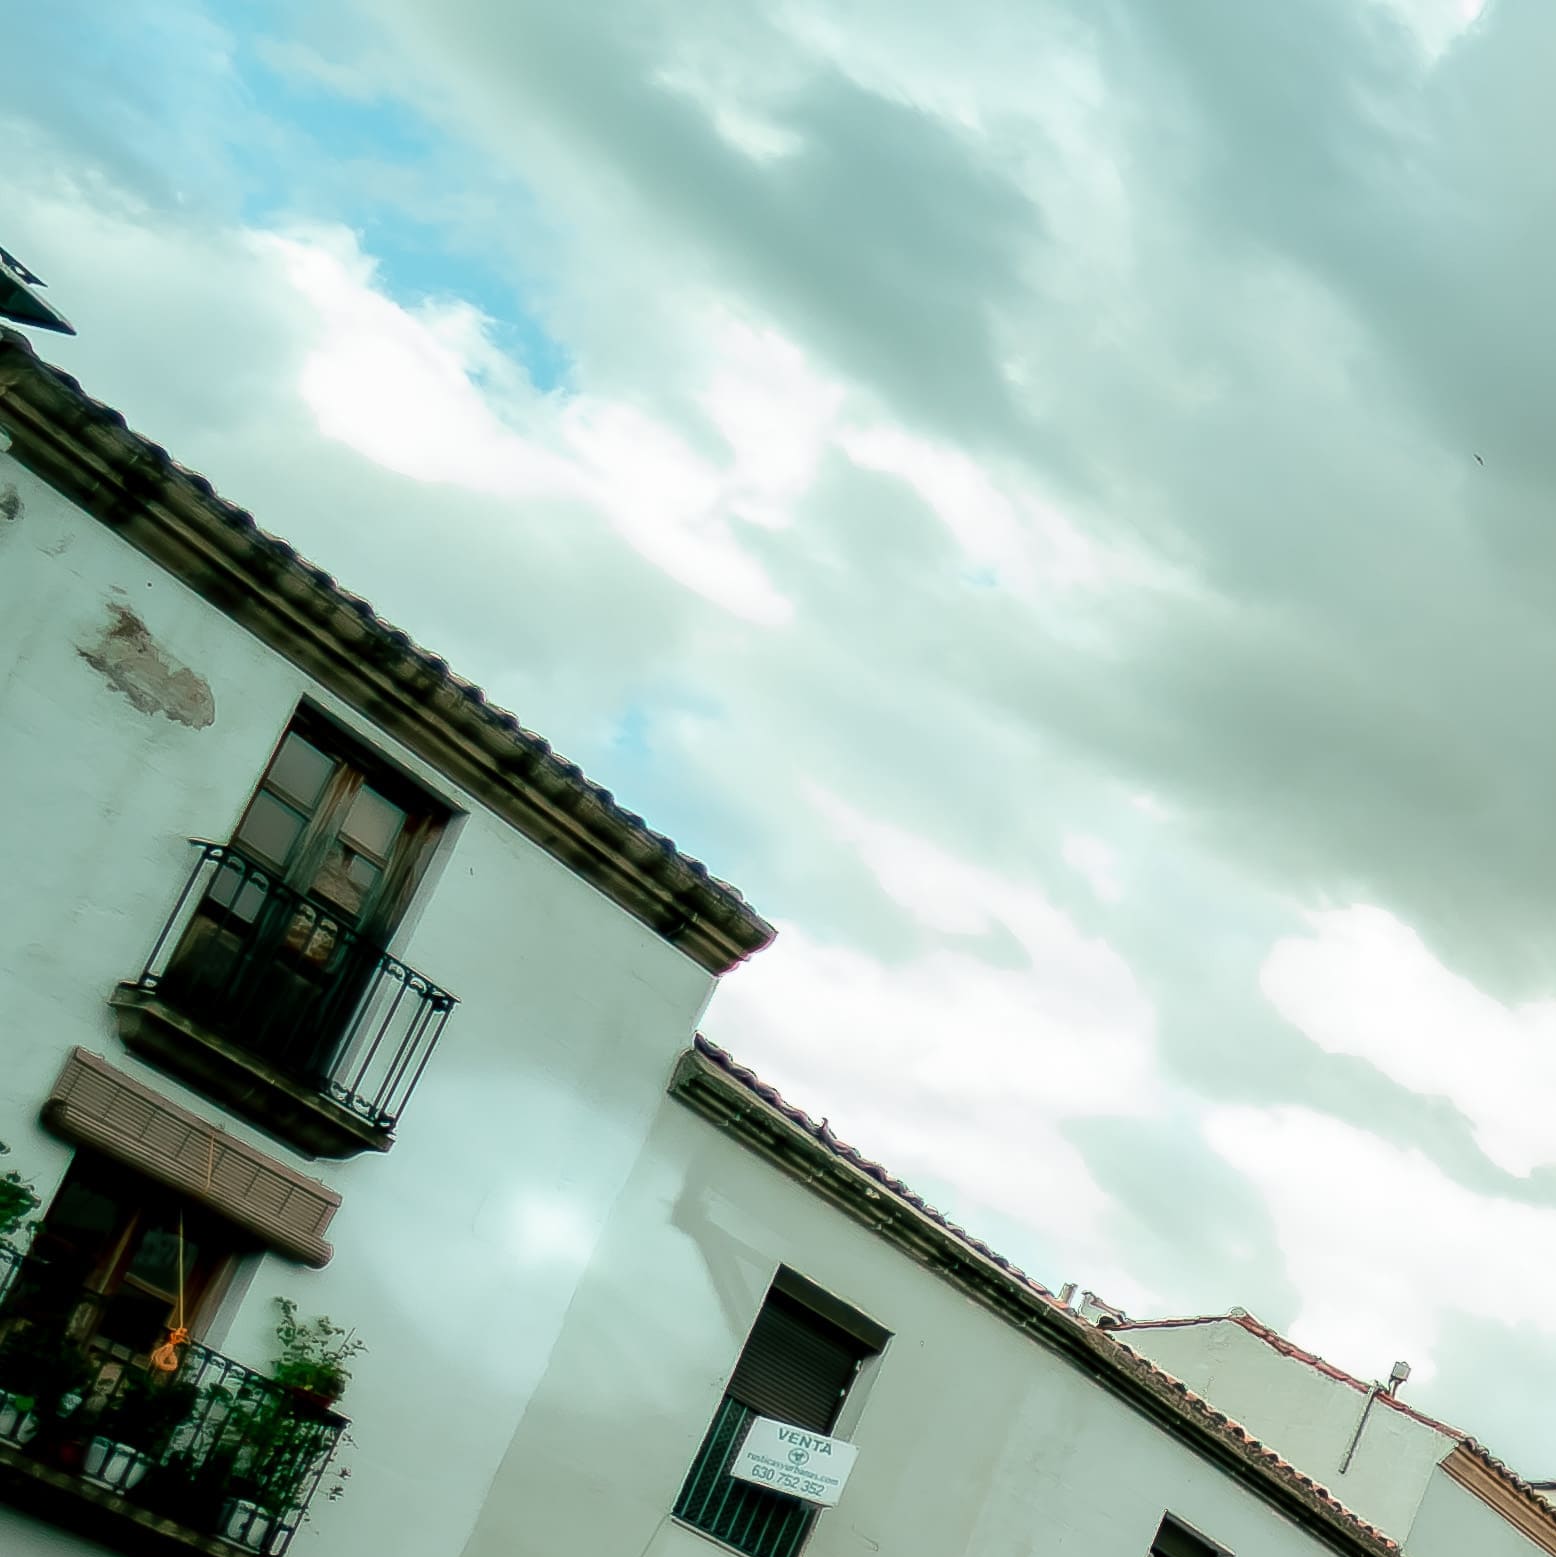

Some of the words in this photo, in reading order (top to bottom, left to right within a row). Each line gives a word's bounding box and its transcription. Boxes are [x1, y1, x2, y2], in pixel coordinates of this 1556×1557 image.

[778, 1428, 832, 1456] VENTA
[752, 1464, 775, 1480] 630
[777, 1472, 800, 1489] 752
[800, 1481, 825, 1497] 352
